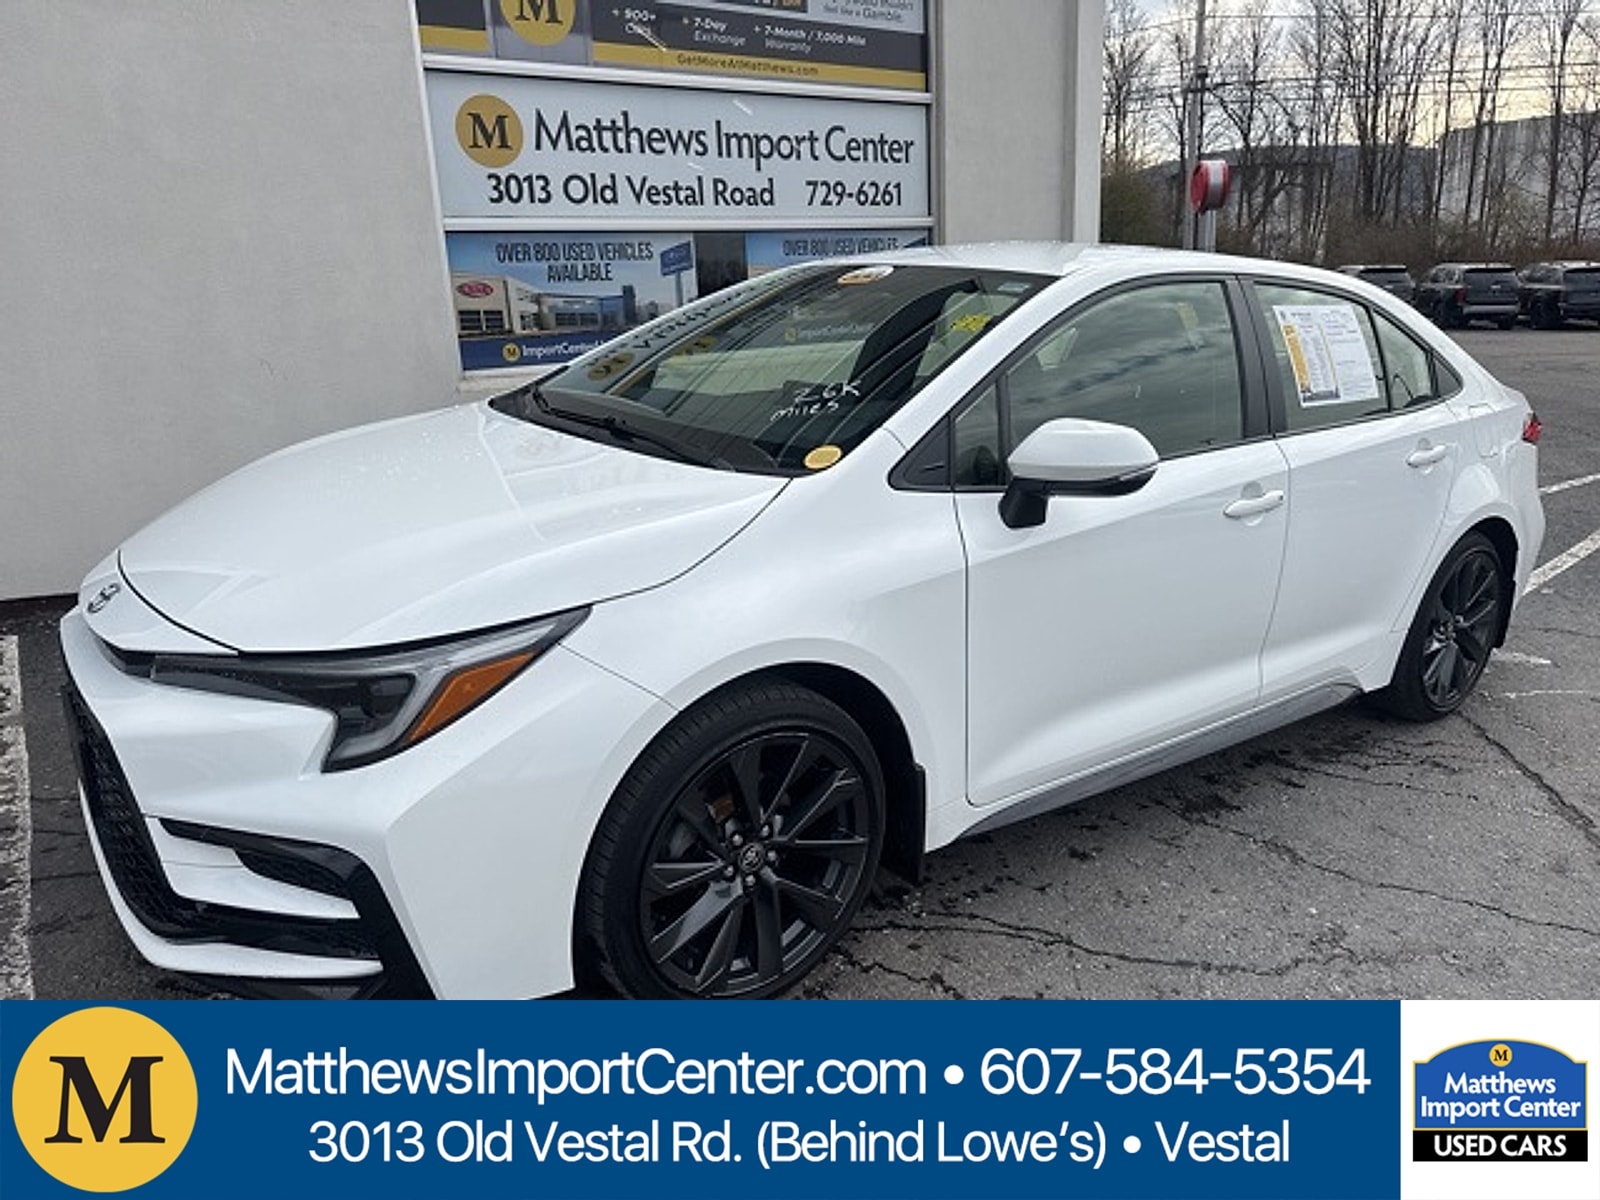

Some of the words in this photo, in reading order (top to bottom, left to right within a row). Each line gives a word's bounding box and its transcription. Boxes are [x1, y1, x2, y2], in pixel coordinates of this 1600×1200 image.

[694, 17, 728, 32] 7-Day
[764, 25, 806, 39] 7-Month
[694, 31, 746, 47] Exchange
[764, 38, 812, 54] Warranty
[677, 53, 819, 76] GetMoreAtMatthews.com
[466, 111, 513, 151] M
[534, 108, 709, 157] Matthews
[716, 119, 819, 172] Import
[824, 126, 915, 164] Center
[487, 172, 552, 204] 3013
[562, 172, 618, 205] Old
[626, 175, 704, 207] Vestal
[713, 178, 775, 207] Road
[805, 180, 902, 207] 729-6261
[495, 243, 531, 264] OVER
[533, 243, 561, 262] 800
[563, 242, 596, 261] USED
[598, 242, 654, 261] VEHICLES
[547, 263, 613, 283] AVAILABLE
